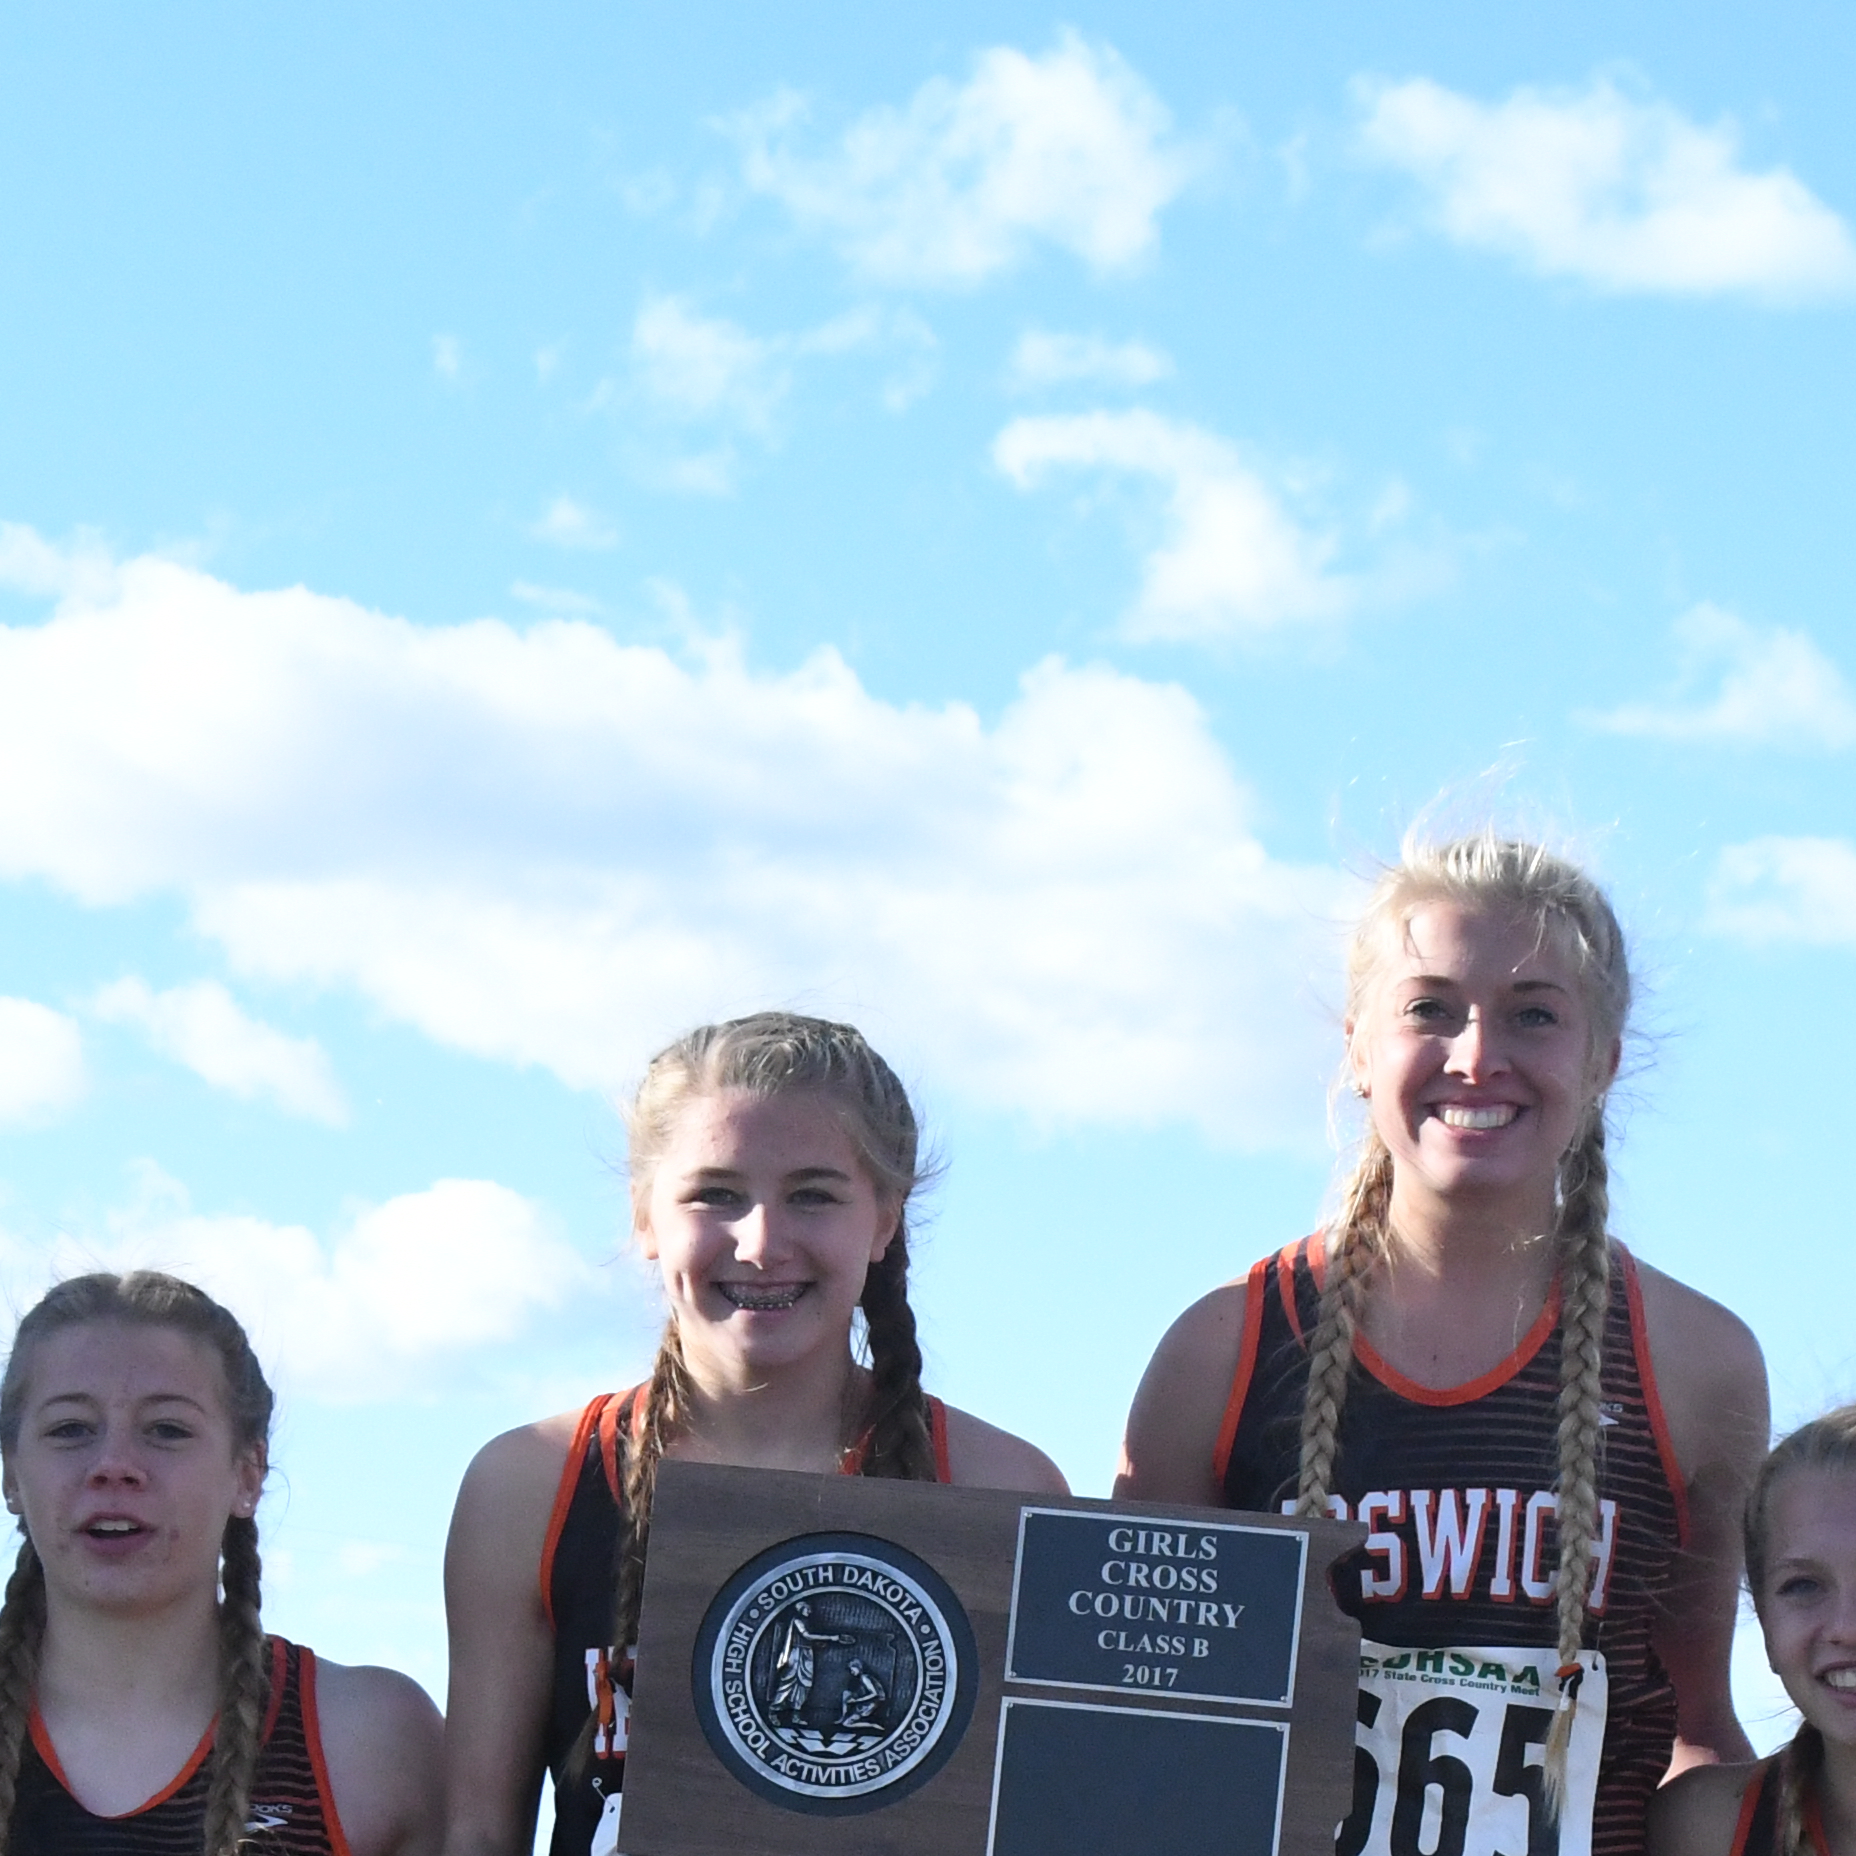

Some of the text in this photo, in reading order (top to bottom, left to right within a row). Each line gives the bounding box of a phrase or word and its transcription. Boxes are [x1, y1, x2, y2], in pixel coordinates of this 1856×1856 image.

[1108, 1528, 1218, 1560] GIRLS
[1282, 1488, 1620, 1617] SWICH
[1101, 1560, 1218, 1593] CROSS
[757, 1566, 924, 1626] SOUTH DAKOTA
[1068, 1590, 1245, 1629] COUNTRY
[1097, 1629, 1210, 1658] CLASS B
[1122, 1664, 1179, 1687] 2017
[1384, 1671, 1417, 1682] State
[1420, 1674, 1456, 1686] Cross
[1459, 1678, 1507, 1693] Country
[1510, 1684, 1540, 1696] Meet
[725, 1622, 944, 1785] HIGH SCHOOL ACTIVITIES ASSOCIATION
